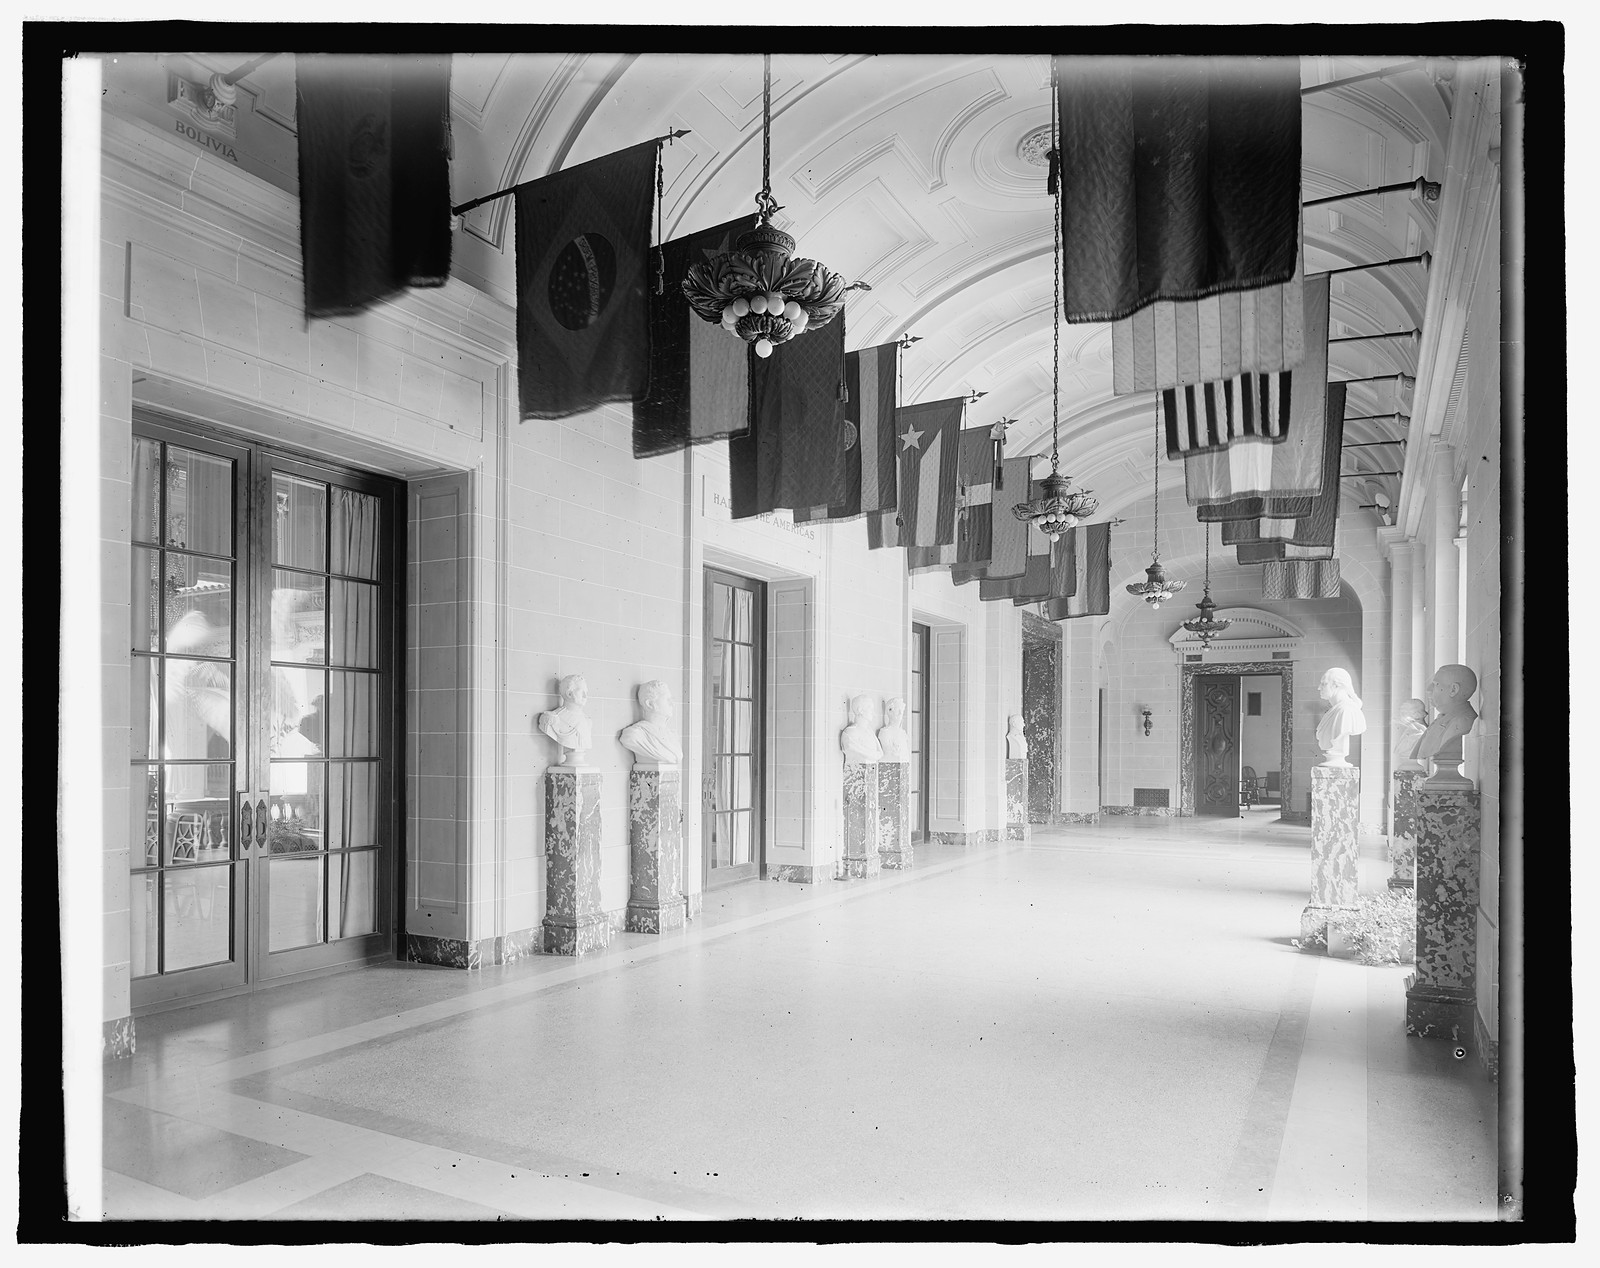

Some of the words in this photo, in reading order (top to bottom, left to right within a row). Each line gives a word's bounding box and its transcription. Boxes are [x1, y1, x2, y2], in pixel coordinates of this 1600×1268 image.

[176, 120, 239, 162] BOLIVIA
[714, 493, 732, 509] HA
[773, 517, 815, 540] AMERICAS
